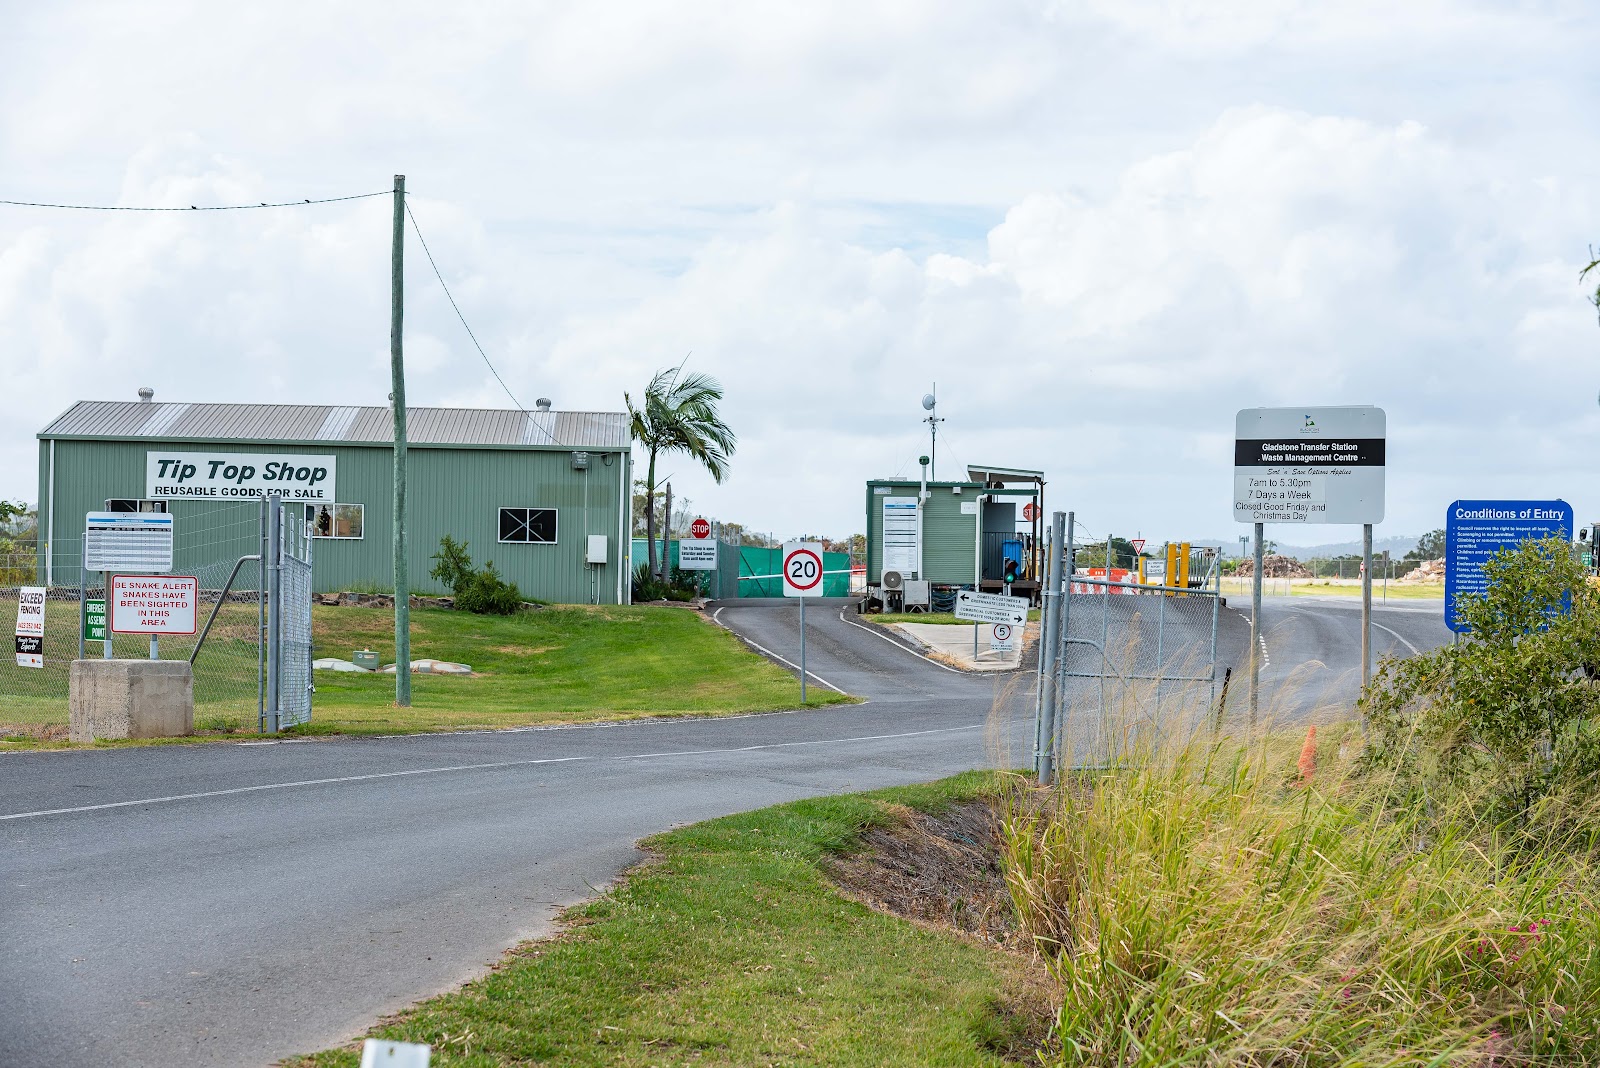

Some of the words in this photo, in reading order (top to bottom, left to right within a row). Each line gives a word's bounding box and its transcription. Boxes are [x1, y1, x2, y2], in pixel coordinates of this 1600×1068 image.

[1262, 443, 1299, 451] Gladstone
[1285, 454, 1331, 463] Management
[157, 459, 196, 483] Tip
[208, 460, 255, 484] Top
[262, 462, 327, 486] Shop
[1330, 468, 1351, 476] Applies
[1280, 479, 1311, 488] 5.30pm
[155, 486, 216, 496] REUSABLE
[221, 488, 263, 497] GOODS
[267, 489, 290, 497] FOR
[295, 489, 324, 498] SALE
[1249, 490, 1253, 498] 7
[1256, 490, 1277, 500] Days
[1288, 491, 1311, 499] Week
[1236, 502, 1261, 510] Closed
[1287, 503, 1309, 512] Friday
[1253, 511, 1290, 519] Christmas
[1293, 512, 1307, 521] Day
[1456, 508, 1516, 518] Conditions
[1520, 508, 1531, 518] of
[1534, 509, 1564, 521] Entry
[692, 525, 708, 533] STOP
[792, 561, 815, 578] 20
[20, 593, 43, 604] EXCEED
[21, 606, 40, 614] FENCING
[92, 628, 104, 637] POINT
[1000, 628, 1005, 636] 5
